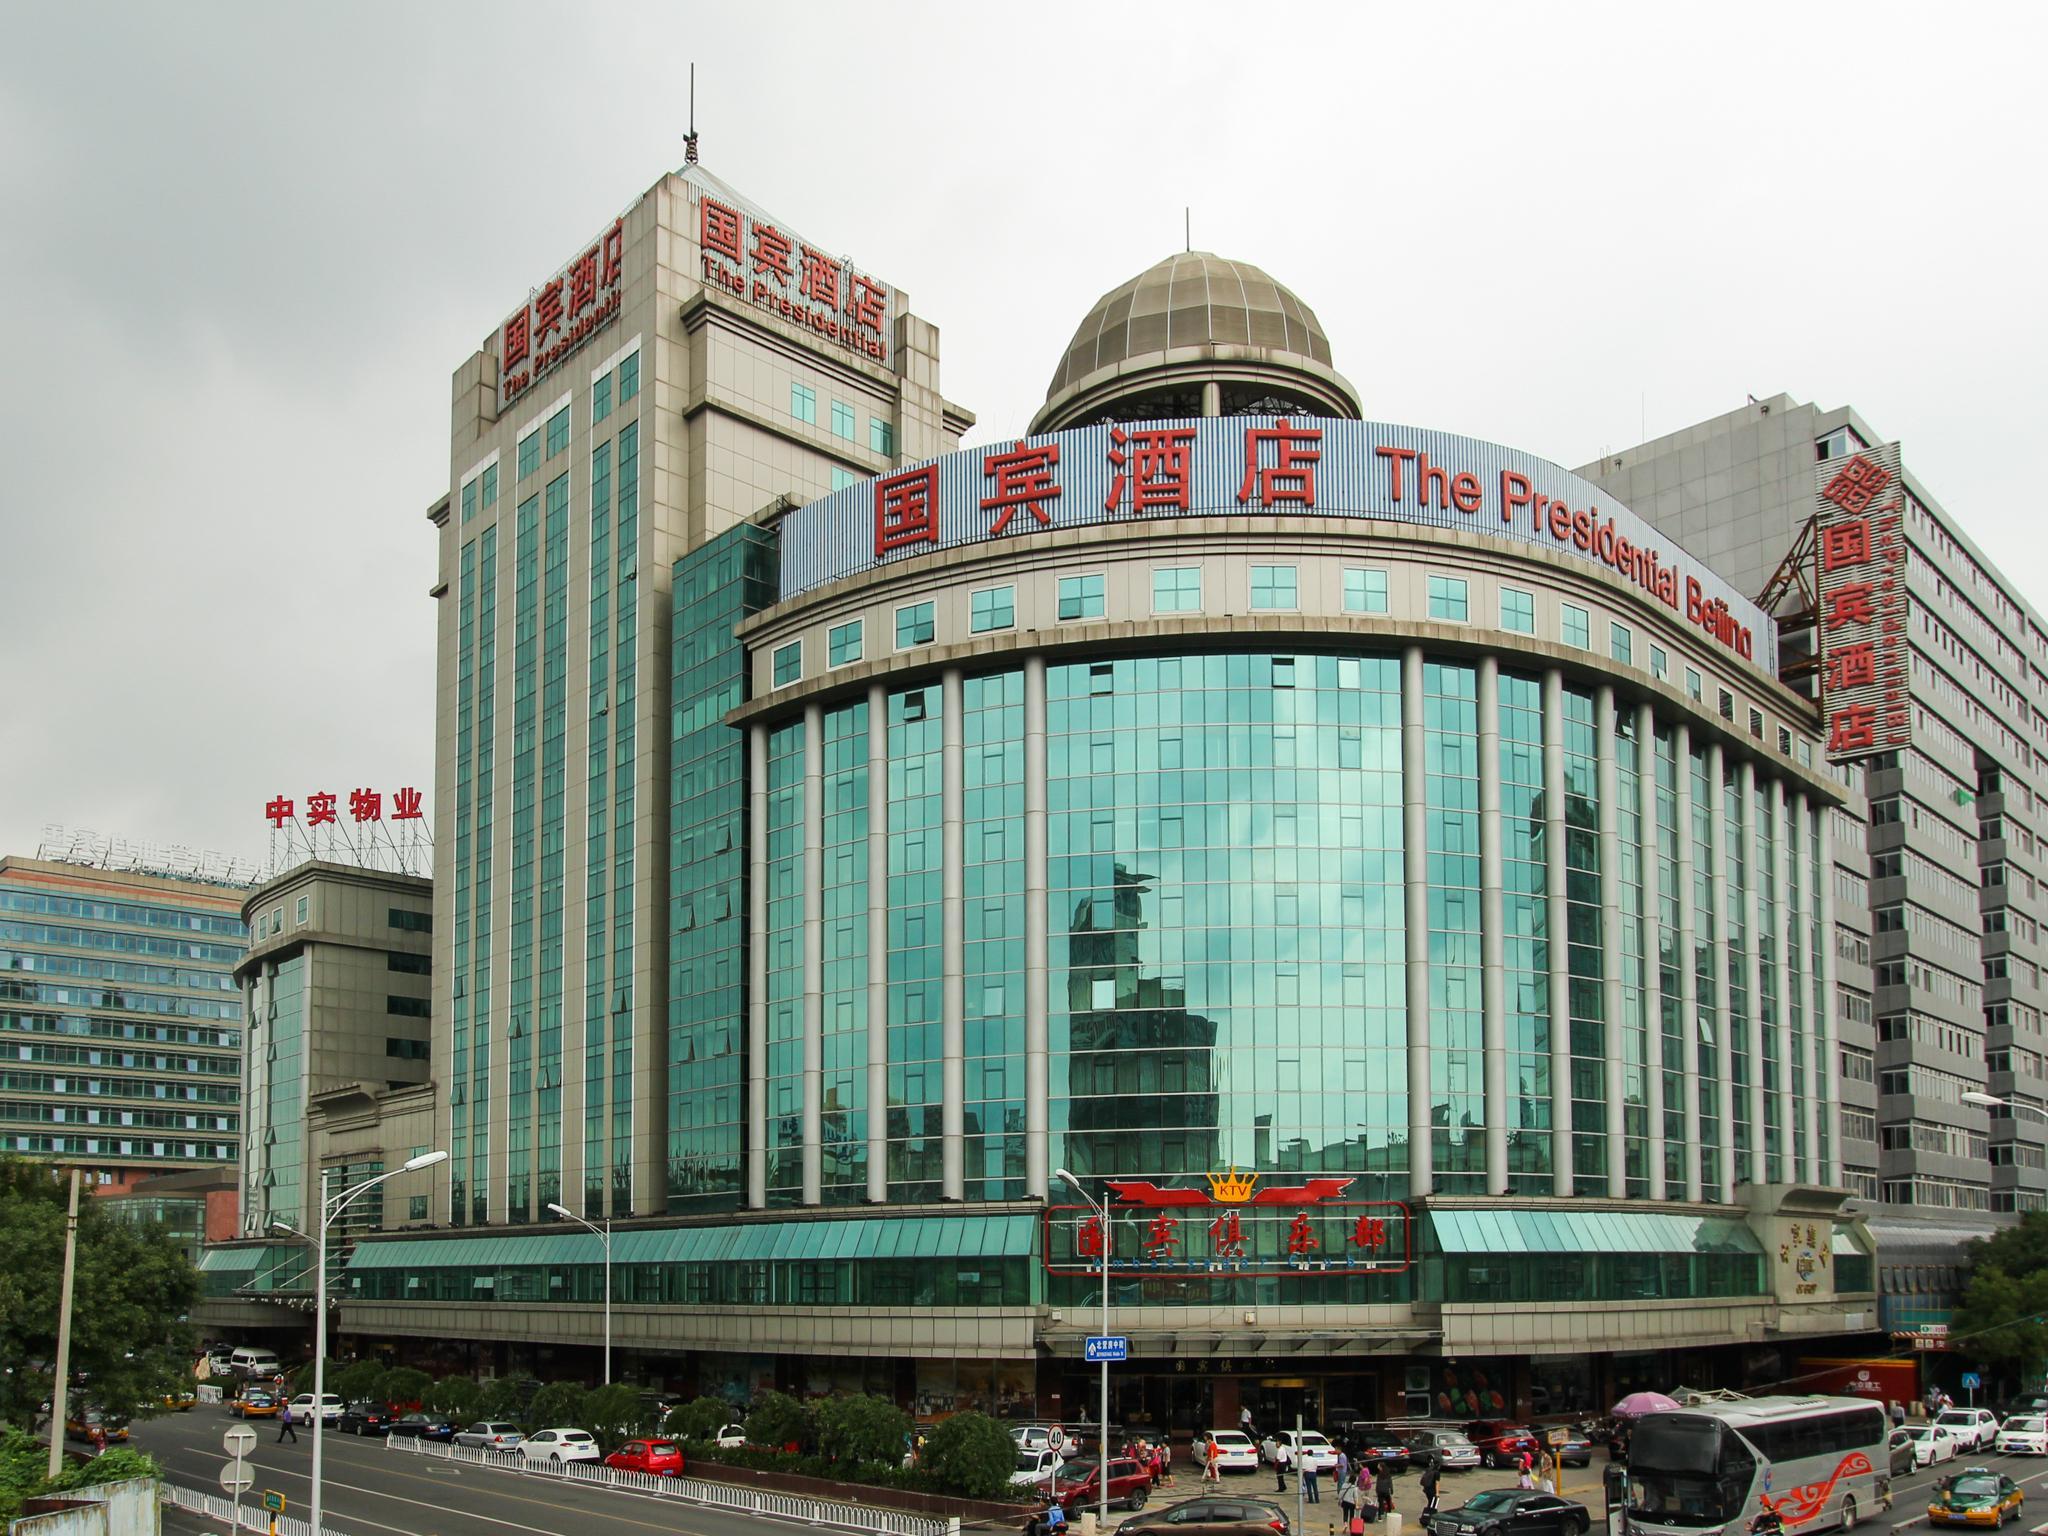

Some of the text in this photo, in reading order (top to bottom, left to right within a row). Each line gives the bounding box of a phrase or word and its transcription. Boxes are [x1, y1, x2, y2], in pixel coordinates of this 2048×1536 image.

[701, 195, 887, 334] 国宾酒店
[702, 253, 887, 361] The Presidential
[503, 370, 530, 401] The
[875, 418, 1323, 557] 国宾酒店
[1376, 446, 1752, 661] The Presidential Beijing
[1823, 518, 1876, 751] 国宾酒店
[266, 787, 423, 829] 中实物业
[1219, 1185, 1248, 1197] KTV
[1288, 1254, 1355, 1268] Club
[1051, 1431, 1061, 1444] 40
